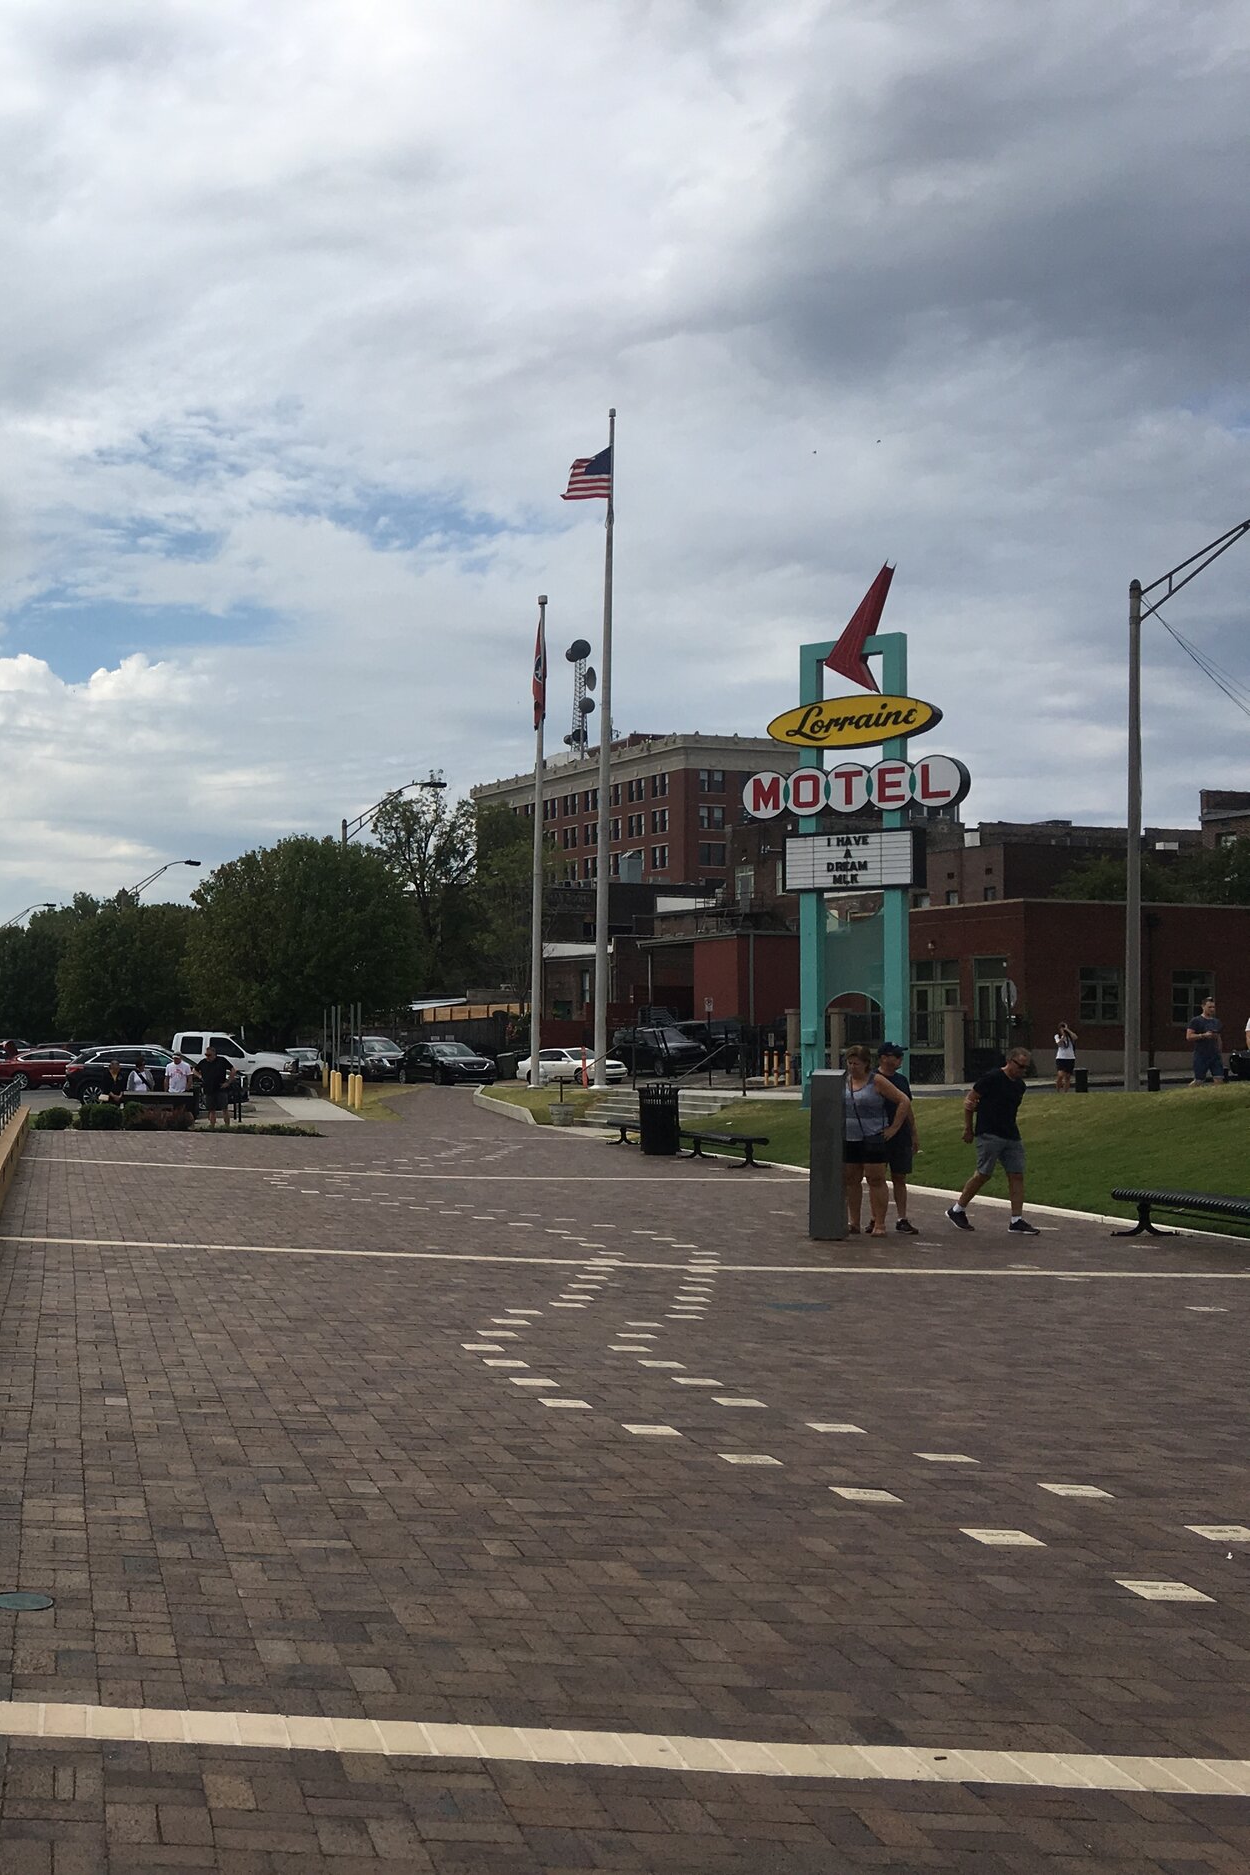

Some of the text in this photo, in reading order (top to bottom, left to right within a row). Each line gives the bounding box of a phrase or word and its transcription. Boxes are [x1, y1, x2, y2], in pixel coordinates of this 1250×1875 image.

[785, 702, 918, 741] Lorraine
[752, 764, 951, 812] MOTEL
[826, 835, 870, 847] I HAVE
[843, 848, 853, 859] A
[826, 860, 868, 872] DREAM
[832, 873, 860, 885] MLK
